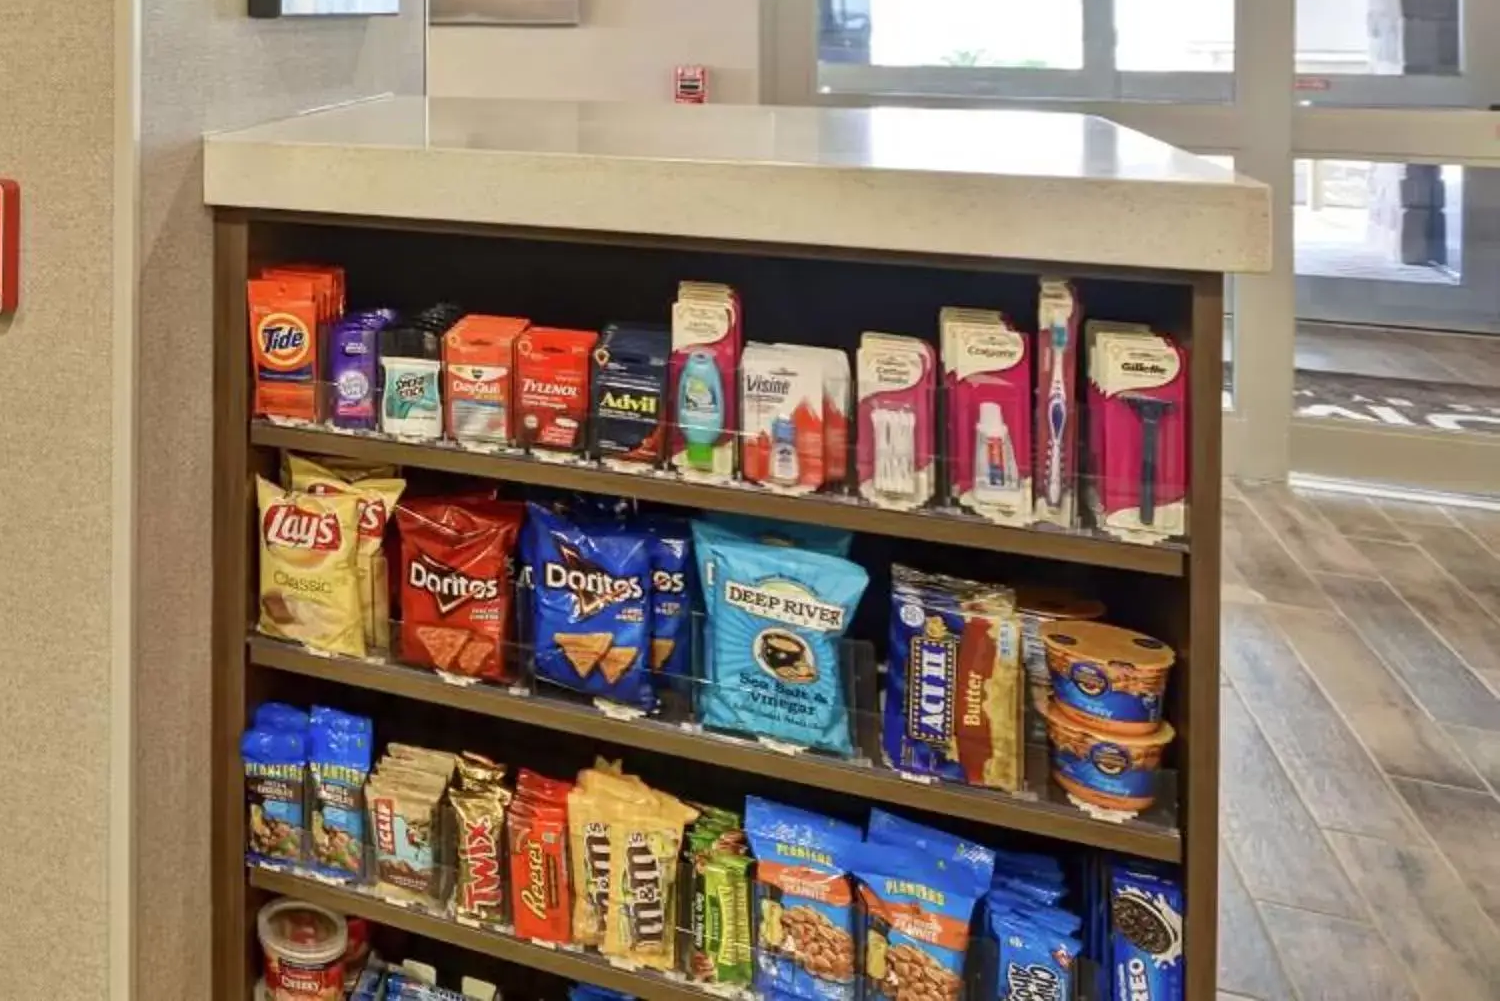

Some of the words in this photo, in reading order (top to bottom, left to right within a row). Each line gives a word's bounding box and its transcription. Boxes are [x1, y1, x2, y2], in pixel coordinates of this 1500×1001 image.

[262, 327, 304, 354] Tide
[522, 378, 579, 397] TYLENOL
[746, 374, 792, 395] Visine
[601, 390, 656, 413] Advil
[267, 505, 336, 548] Lay's
[273, 570, 333, 594] Classic
[410, 561, 499, 600] Doritos
[545, 562, 643, 601] Doritos
[729, 585, 781, 608] DEEP
[783, 598, 842, 625] RIVER
[739, 672, 769, 690] Sea
[749, 691, 816, 716] Vinegar
[962, 670, 984, 727] Butter
[464, 816, 501, 913] TWIX
